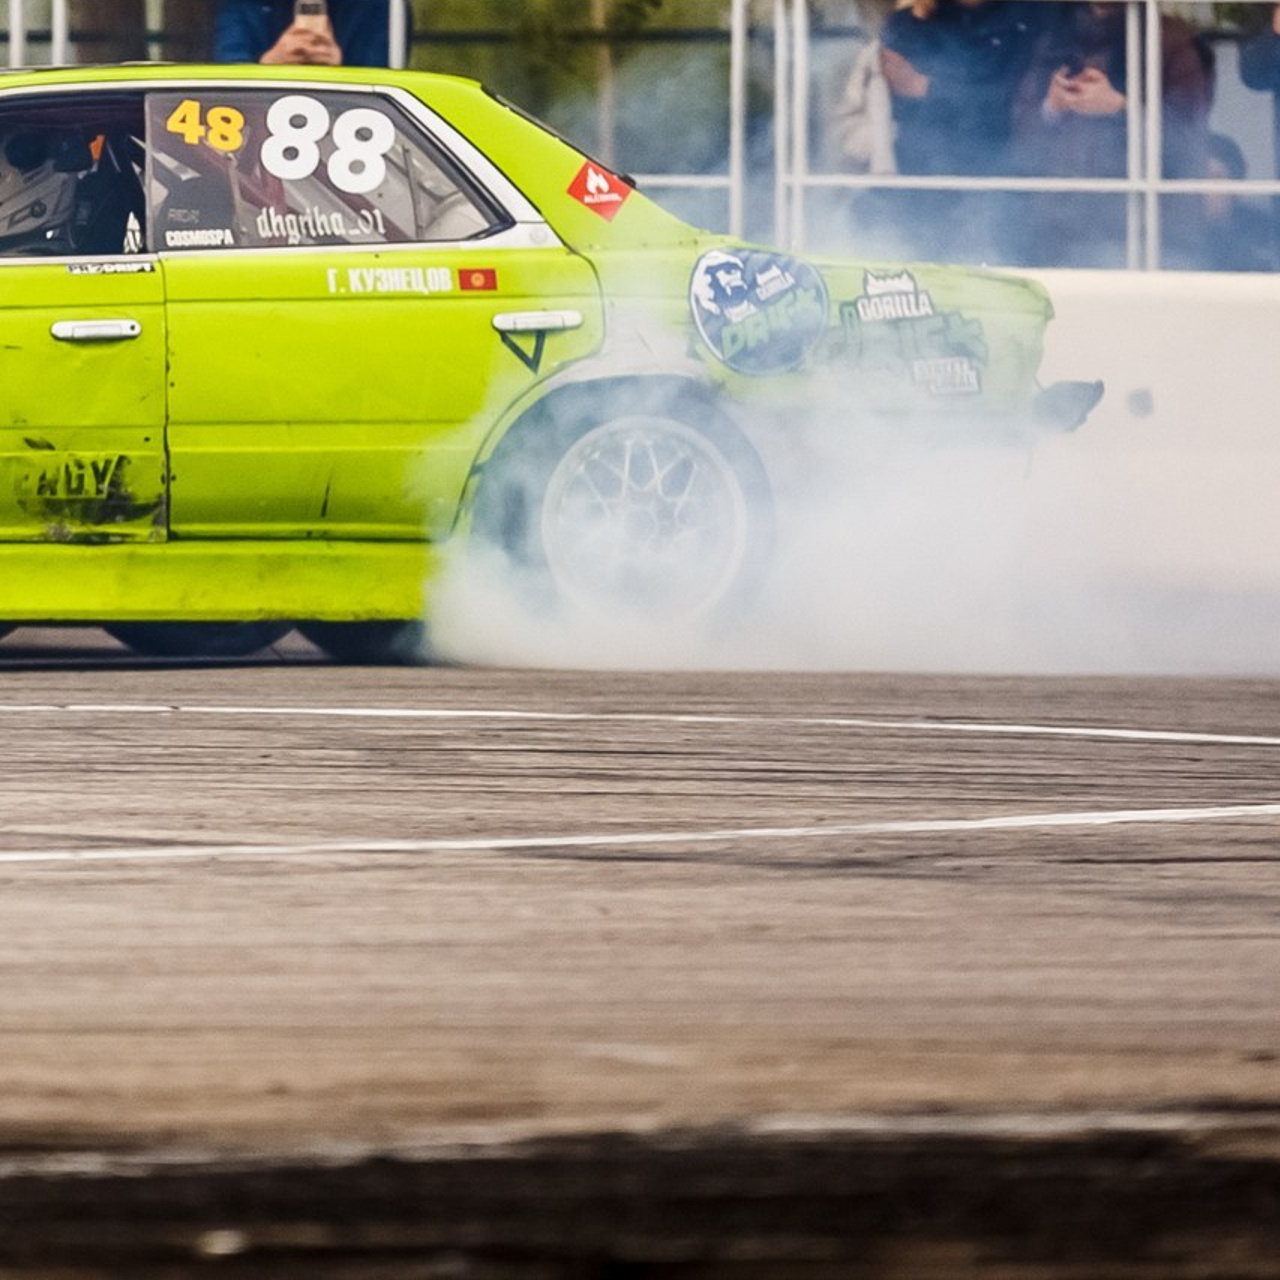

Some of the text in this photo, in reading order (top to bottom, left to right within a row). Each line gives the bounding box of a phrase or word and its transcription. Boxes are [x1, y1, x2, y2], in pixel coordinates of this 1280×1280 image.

[166, 99, 244, 151] 48
[260, 95, 395, 193] 88
[327, 267, 452, 295] Г. КУЗНЕЦОВ
[857, 291, 934, 322] GORILLA
